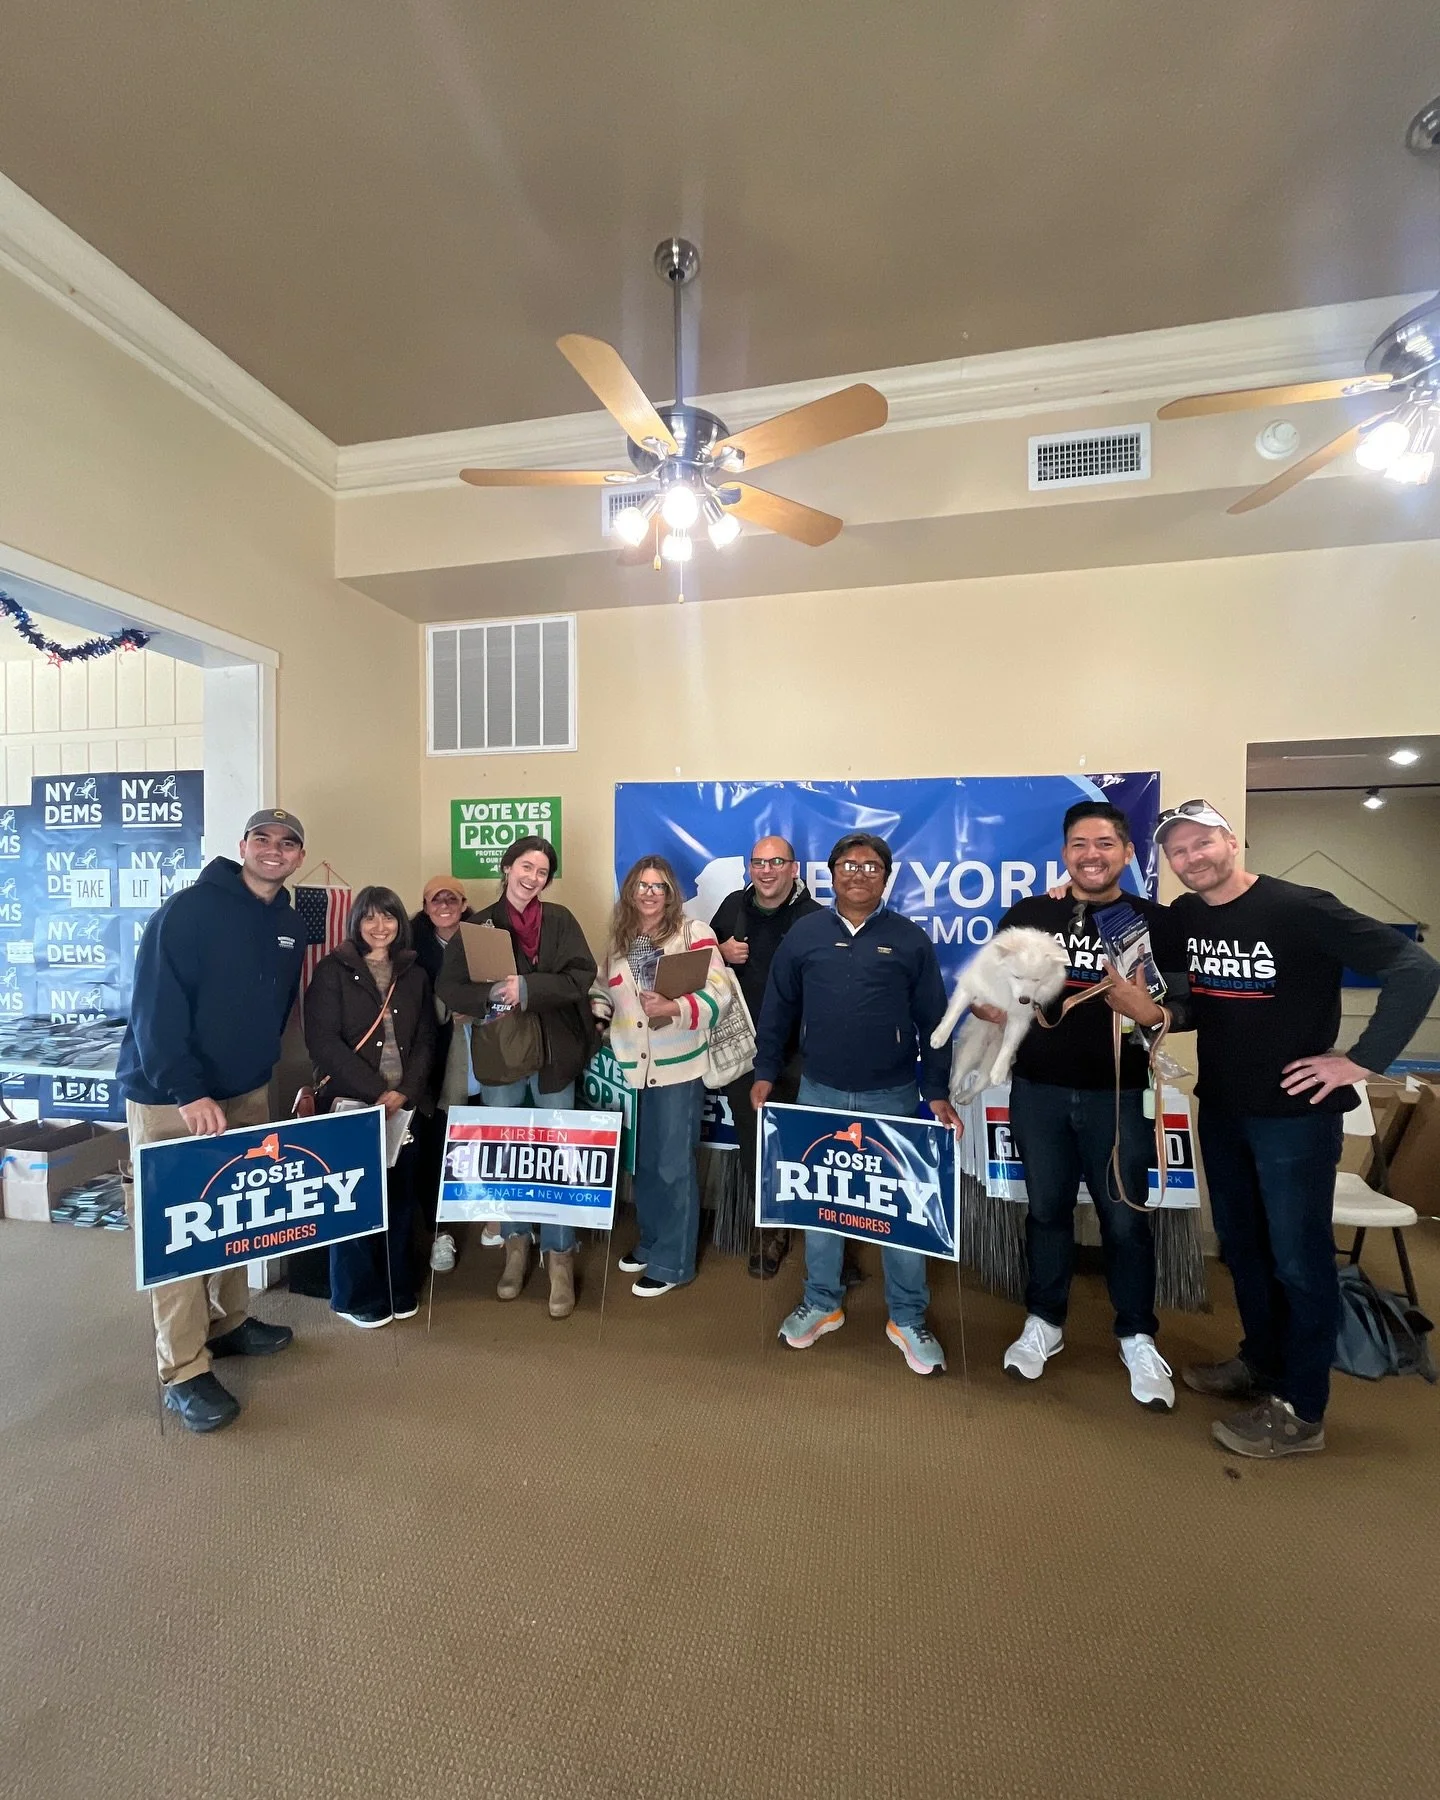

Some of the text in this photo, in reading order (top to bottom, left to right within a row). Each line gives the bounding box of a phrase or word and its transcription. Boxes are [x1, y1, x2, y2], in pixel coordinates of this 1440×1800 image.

[45, 782, 76, 802] NY
[121, 779, 154, 799] NY
[45, 804, 102, 824] DEMS
[122, 802, 183, 822] DEMS
[461, 802, 552, 821] VOTE YES
[46, 852, 76, 871] NY
[131, 851, 163, 869] NY
[47, 875, 71, 893] DE
[77, 879, 104, 898] TAKE
[133, 879, 149, 898] LIT
[48, 921, 78, 941] NY
[47, 944, 106, 963] DEMS
[1186, 937, 1274, 959] AMALA
[1189, 955, 1277, 979] ARRIS
[51, 990, 81, 1010] NY
[500, 1128, 568, 1142] KIRSTEN
[452, 1145, 608, 1184] GILLIBRAND
[823, 1149, 882, 1173] JOSH
[231, 1160, 305, 1191] JOSH
[479, 1187, 524, 1198] SENATE
[538, 1190, 600, 1203] NEW YORK
[776, 1160, 938, 1227] RILEY
[164, 1168, 365, 1255] RILEY
[818, 1207, 891, 1235] FOR CONGRESS
[225, 1223, 317, 1256] FOR CONGRESS
